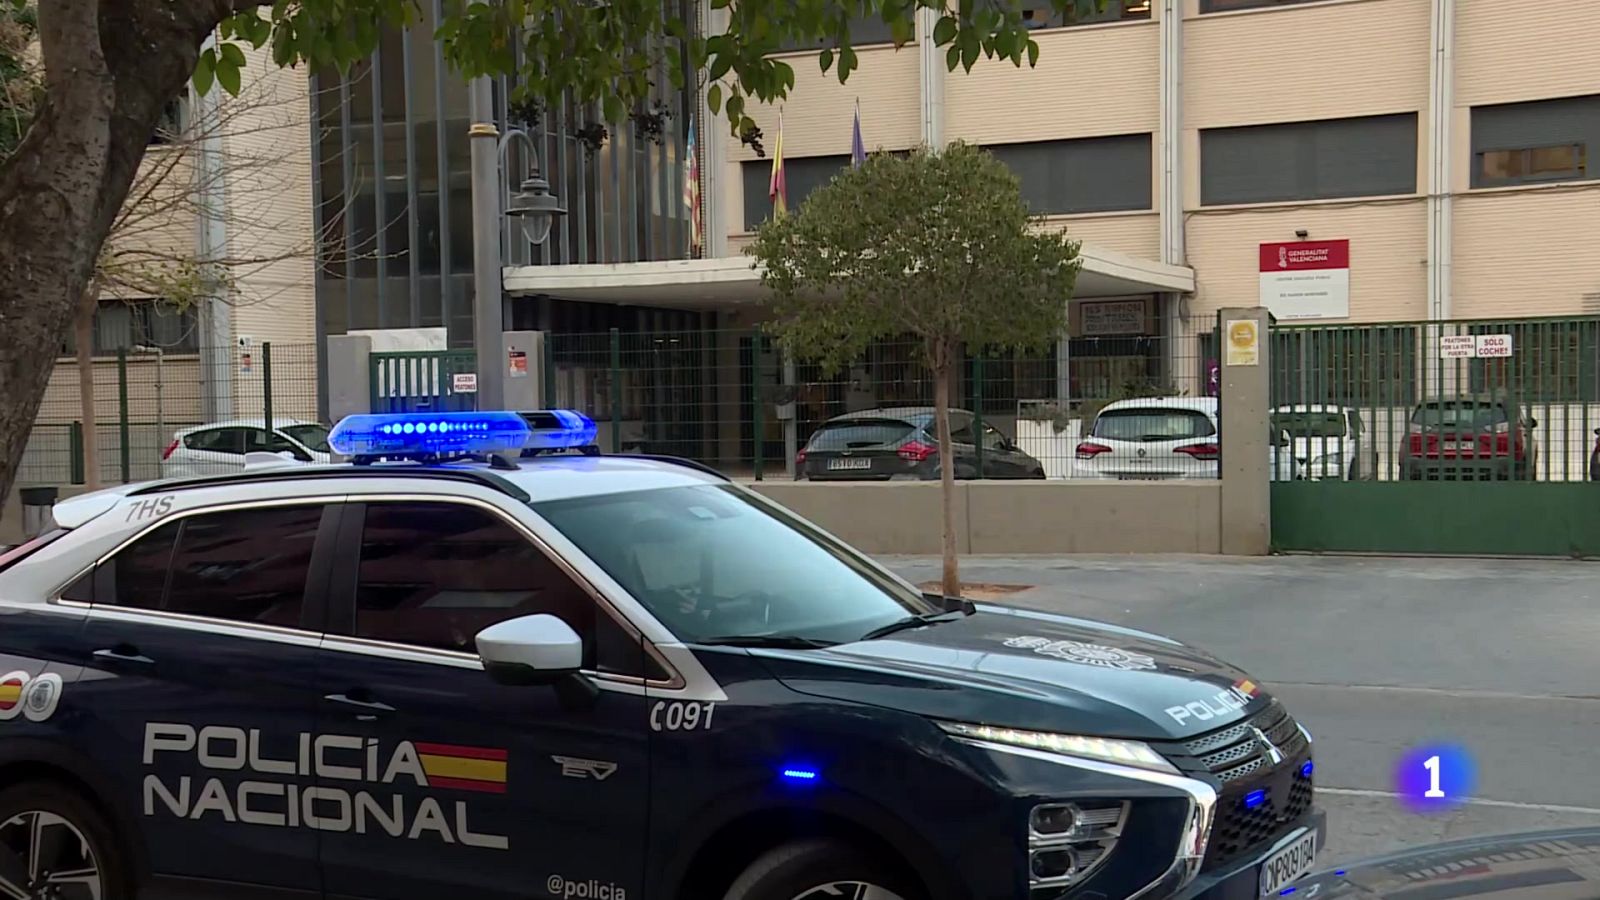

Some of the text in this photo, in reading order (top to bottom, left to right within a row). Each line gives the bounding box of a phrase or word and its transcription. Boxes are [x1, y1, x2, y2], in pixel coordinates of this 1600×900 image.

[1288, 249, 1329, 257] GENERALITAT
[1289, 255, 1328, 263] VALENCIANA
[1484, 338, 1504, 346] SOLO
[126, 495, 175, 523] 7HS
[666, 701, 715, 731] 091
[143, 773, 509, 850] NACIONAL
[547, 874, 627, 900] @policia
